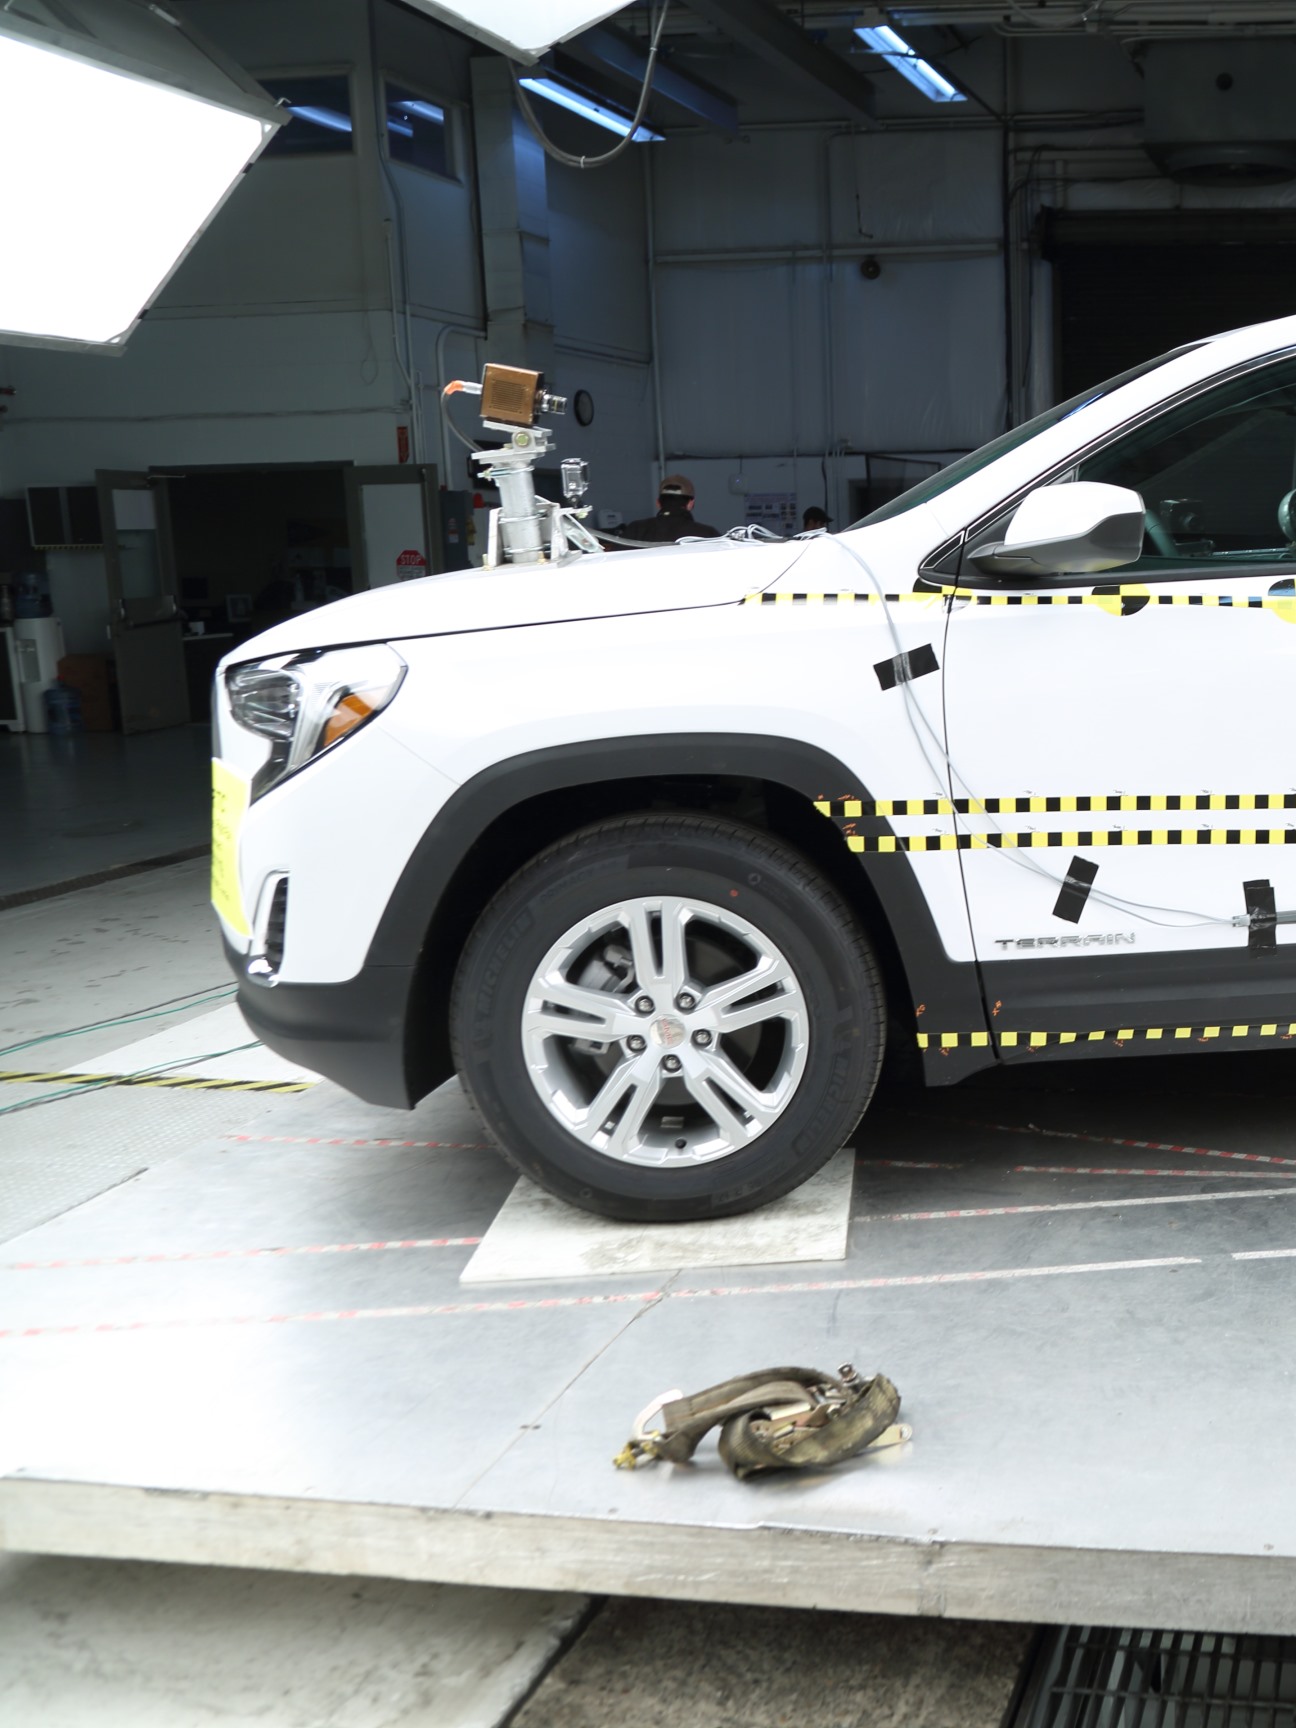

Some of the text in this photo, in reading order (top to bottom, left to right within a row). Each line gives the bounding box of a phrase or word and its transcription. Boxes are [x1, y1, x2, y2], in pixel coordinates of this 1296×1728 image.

[400, 554, 422, 565] STOP
[995, 932, 1136, 950] TERRAIN
[477, 911, 531, 1014] MICHELIN
